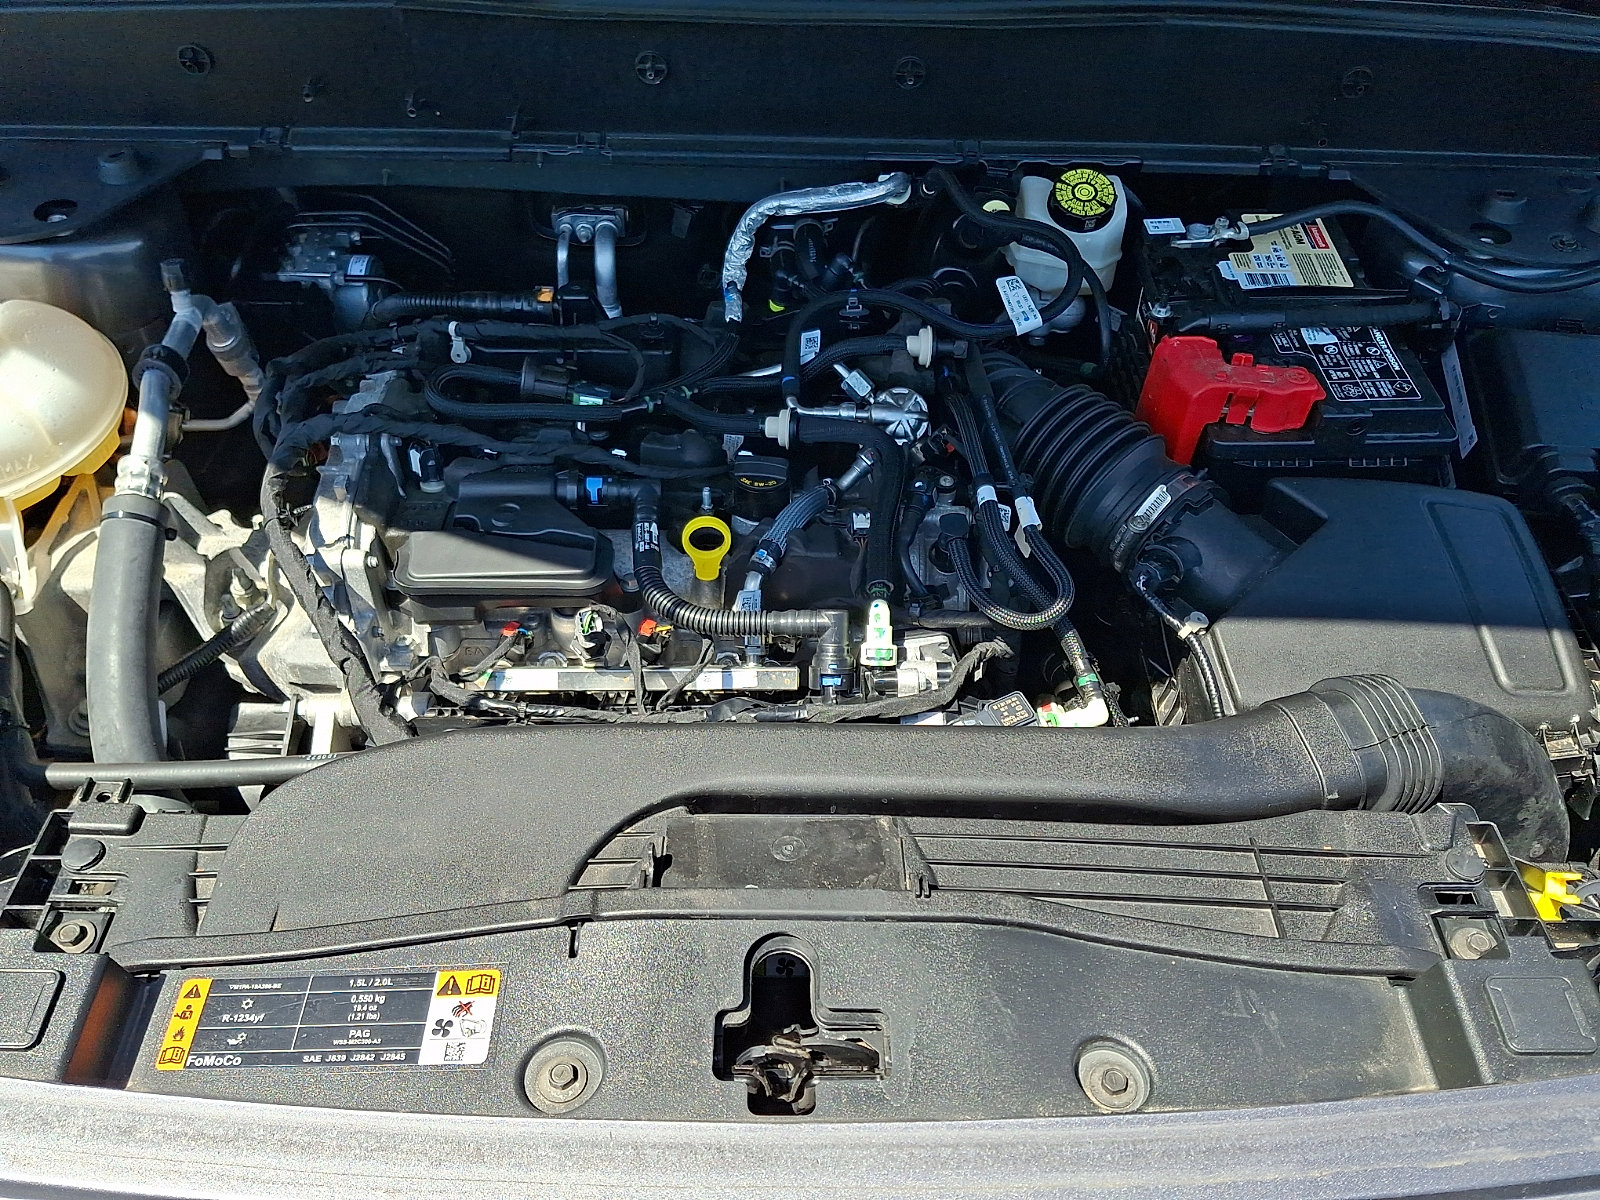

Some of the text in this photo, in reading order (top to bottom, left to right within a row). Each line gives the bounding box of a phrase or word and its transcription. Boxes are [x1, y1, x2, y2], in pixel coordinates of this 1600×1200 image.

[1291, 230, 1306, 245] AGM
[349, 979, 367, 987] 1.5L
[374, 978, 394, 987] 2.0L
[350, 994, 386, 1004] 0.550 kg
[221, 1013, 266, 1024] R-1234yf
[348, 1029, 371, 1038] PAG
[186, 1054, 242, 1067] FoMoCo
[302, 1055, 323, 1063] SAE
[350, 1053, 376, 1062] J2842
[380, 1053, 406, 1061] J2845
